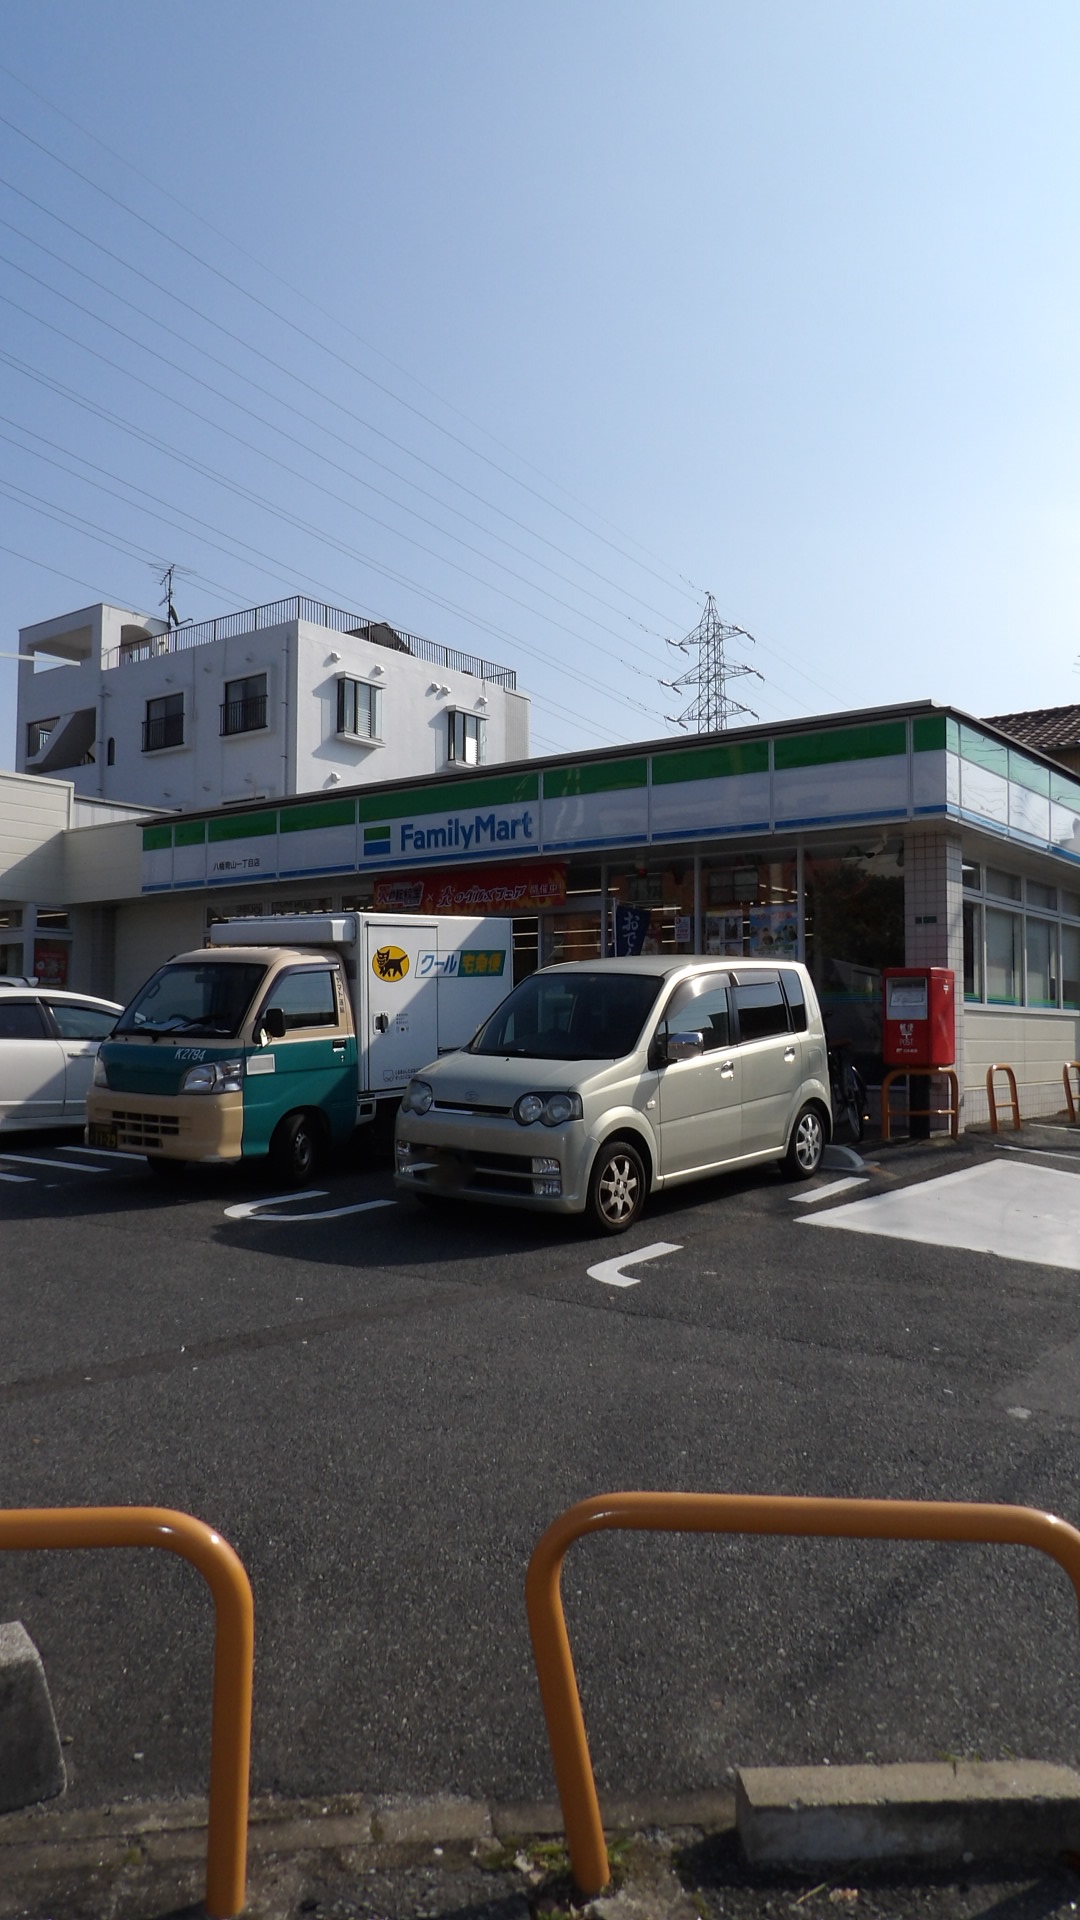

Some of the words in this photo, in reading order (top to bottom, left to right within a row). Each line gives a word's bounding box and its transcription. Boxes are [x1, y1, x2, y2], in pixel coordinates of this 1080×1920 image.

[401, 811, 532, 851] FamilyMart
[899, 1038, 914, 1046] POST
[174, 1048, 207, 1062] K2794
